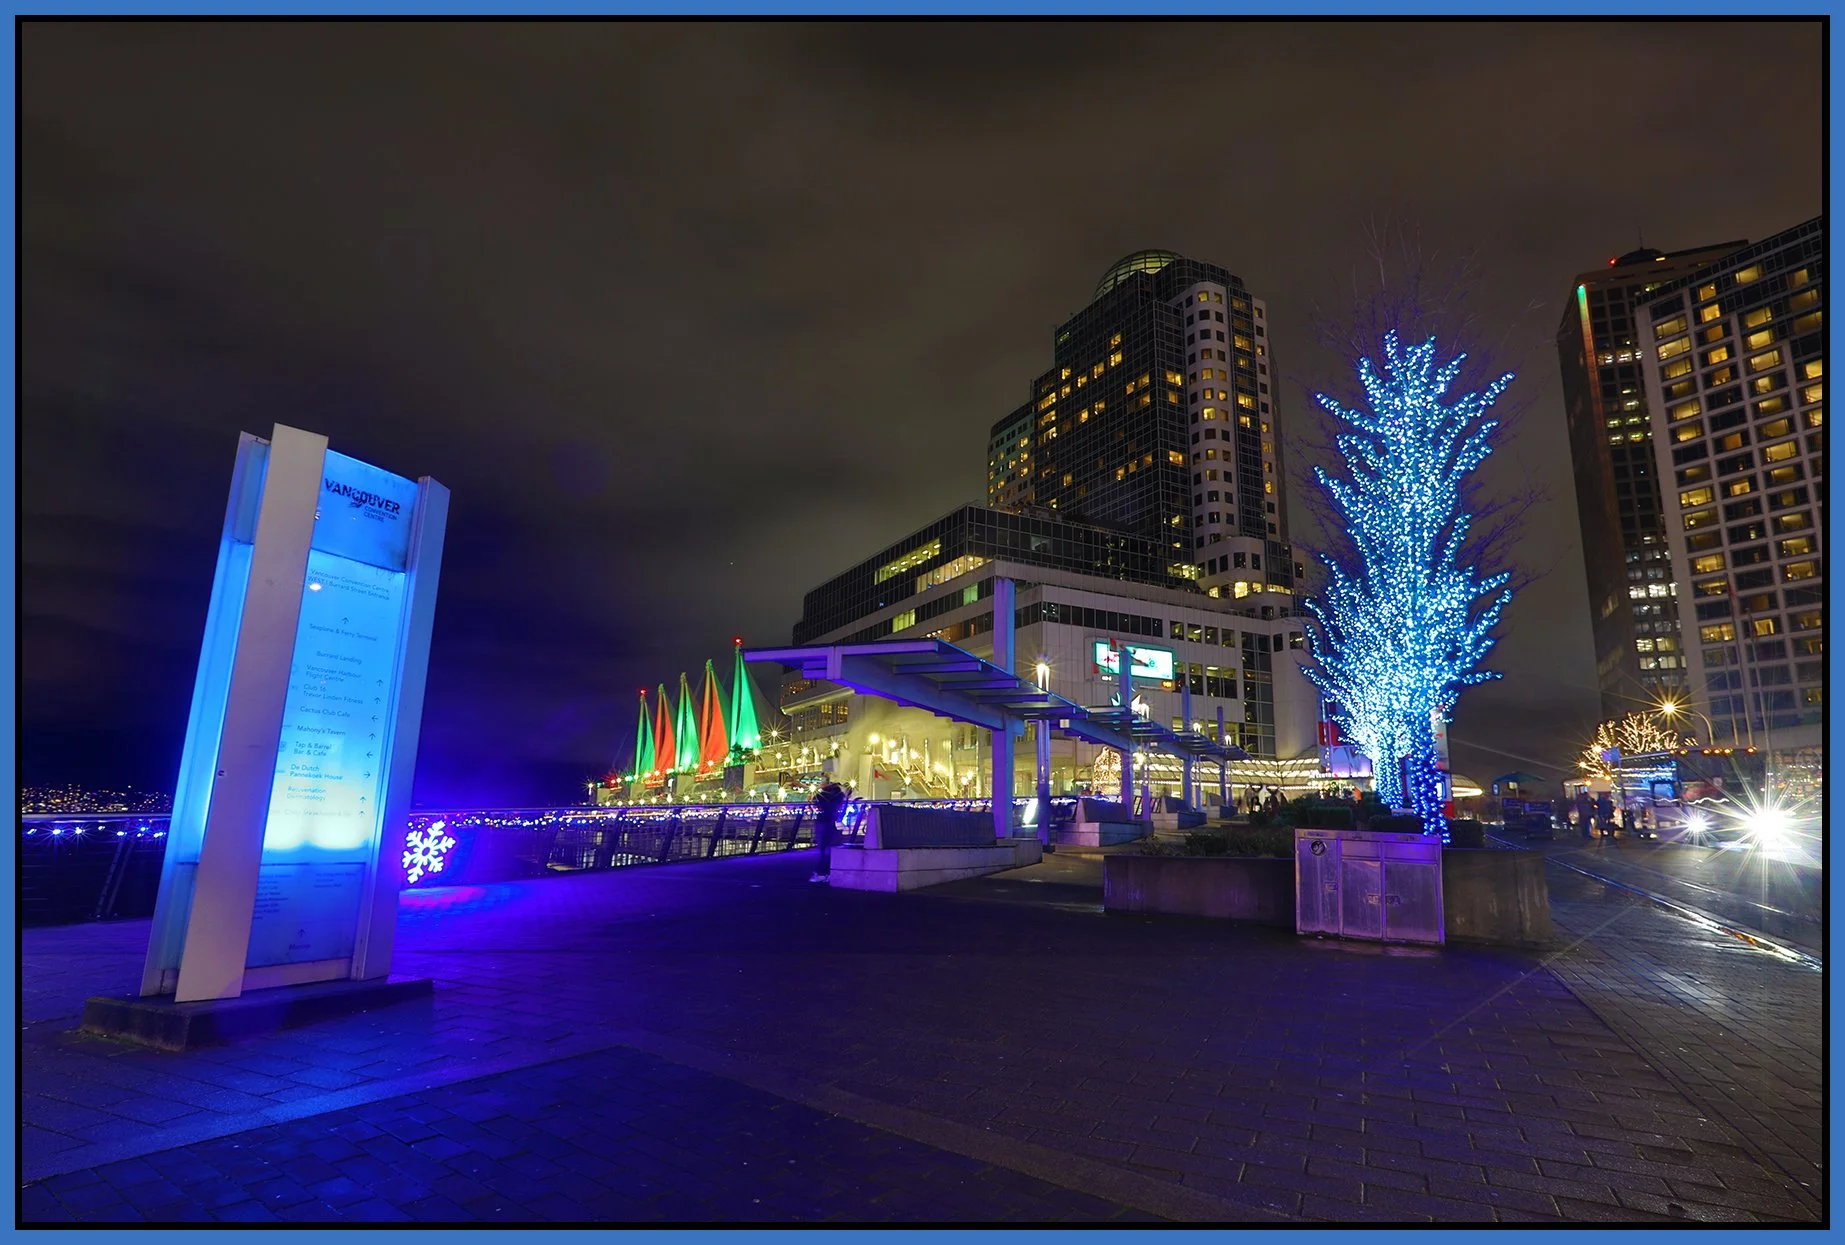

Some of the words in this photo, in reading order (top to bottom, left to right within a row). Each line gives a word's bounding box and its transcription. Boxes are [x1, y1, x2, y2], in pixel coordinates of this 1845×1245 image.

[325, 478, 400, 515] VANCOUVER
[363, 512, 384, 523] CENTRE
[364, 506, 397, 520] CONVENTION
[311, 569, 340, 580] Vancouver
[341, 577, 371, 588] Convention
[372, 584, 389, 593] Centre
[329, 581, 350, 590] Burrard
[350, 586, 367, 594] Street
[367, 589, 390, 600] Entrance
[341, 629, 355, 638] Ferry
[316, 650, 339, 660] Burrard
[339, 655, 362, 665] Landing
[305, 671, 323, 679] Flight
[324, 674, 344, 682] Centre
[306, 664, 337, 674] Vancouver
[338, 670, 361, 678] Harbour
[303, 683, 318, 691] Club
[303, 690, 321, 698] Trevor
[322, 693, 342, 701] Linden
[343, 696, 363, 704] Fitness
[300, 705, 321, 714] Cactus
[321, 708, 337, 716] Club
[297, 725, 326, 735] Mahony's
[327, 728, 346, 736] Tavern
[295, 740, 306, 748] Tap
[301, 764, 320, 772] Dutch
[287, 785, 326, 793] Revenation
